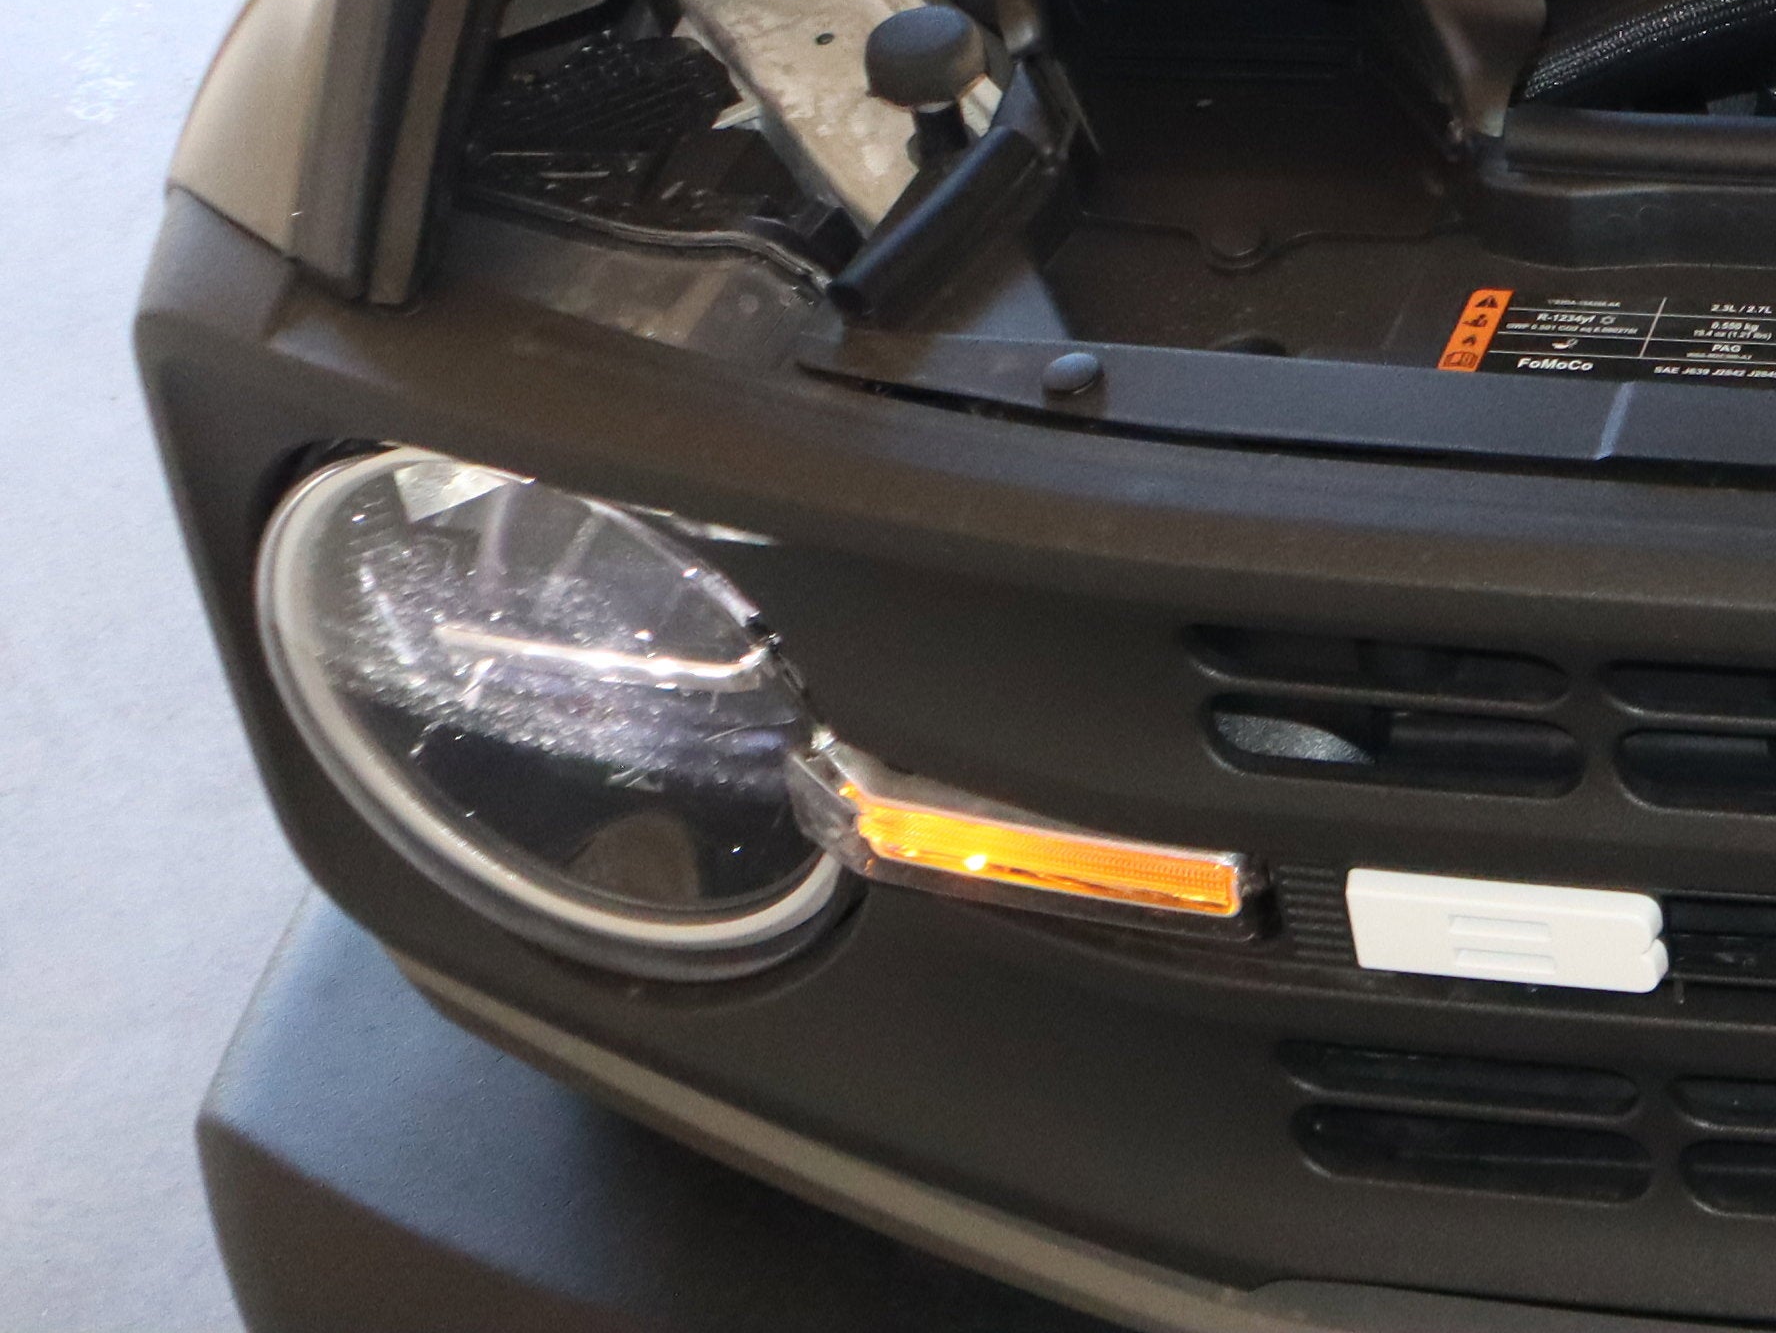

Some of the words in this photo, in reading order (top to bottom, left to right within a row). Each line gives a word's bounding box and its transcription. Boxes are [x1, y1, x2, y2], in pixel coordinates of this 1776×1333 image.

[1746, 305, 1773, 314] 2.7L
[1535, 312, 1597, 325] R-1234yf
[1743, 322, 1760, 333] kg
[1711, 344, 1742, 353] PAG
[1516, 357, 1595, 372] FoMoCo
[1653, 366, 1681, 375] SAE
